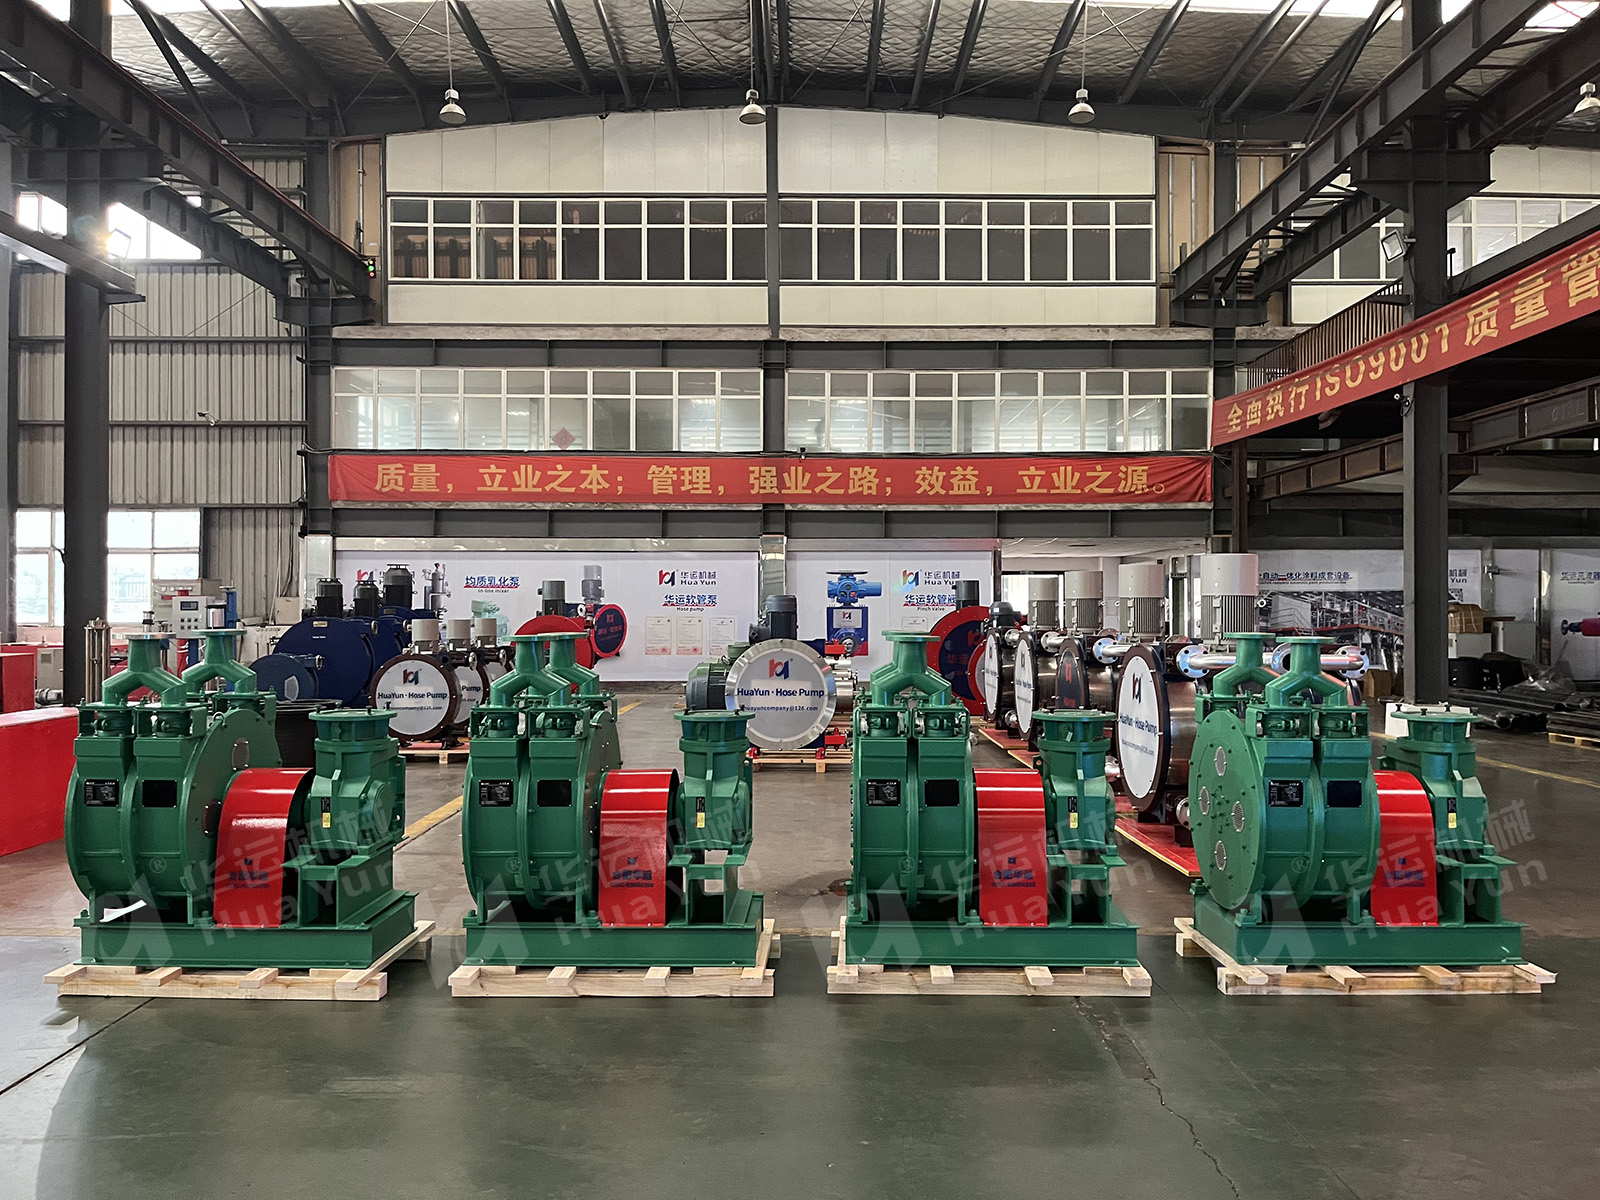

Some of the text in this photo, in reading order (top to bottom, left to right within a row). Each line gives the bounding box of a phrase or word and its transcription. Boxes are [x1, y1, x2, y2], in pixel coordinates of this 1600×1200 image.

[664, 594, 717, 605] 华运软管泵
[426, 691, 448, 700] Pump
[737, 687, 825, 698] HuaYun Hose Pump
